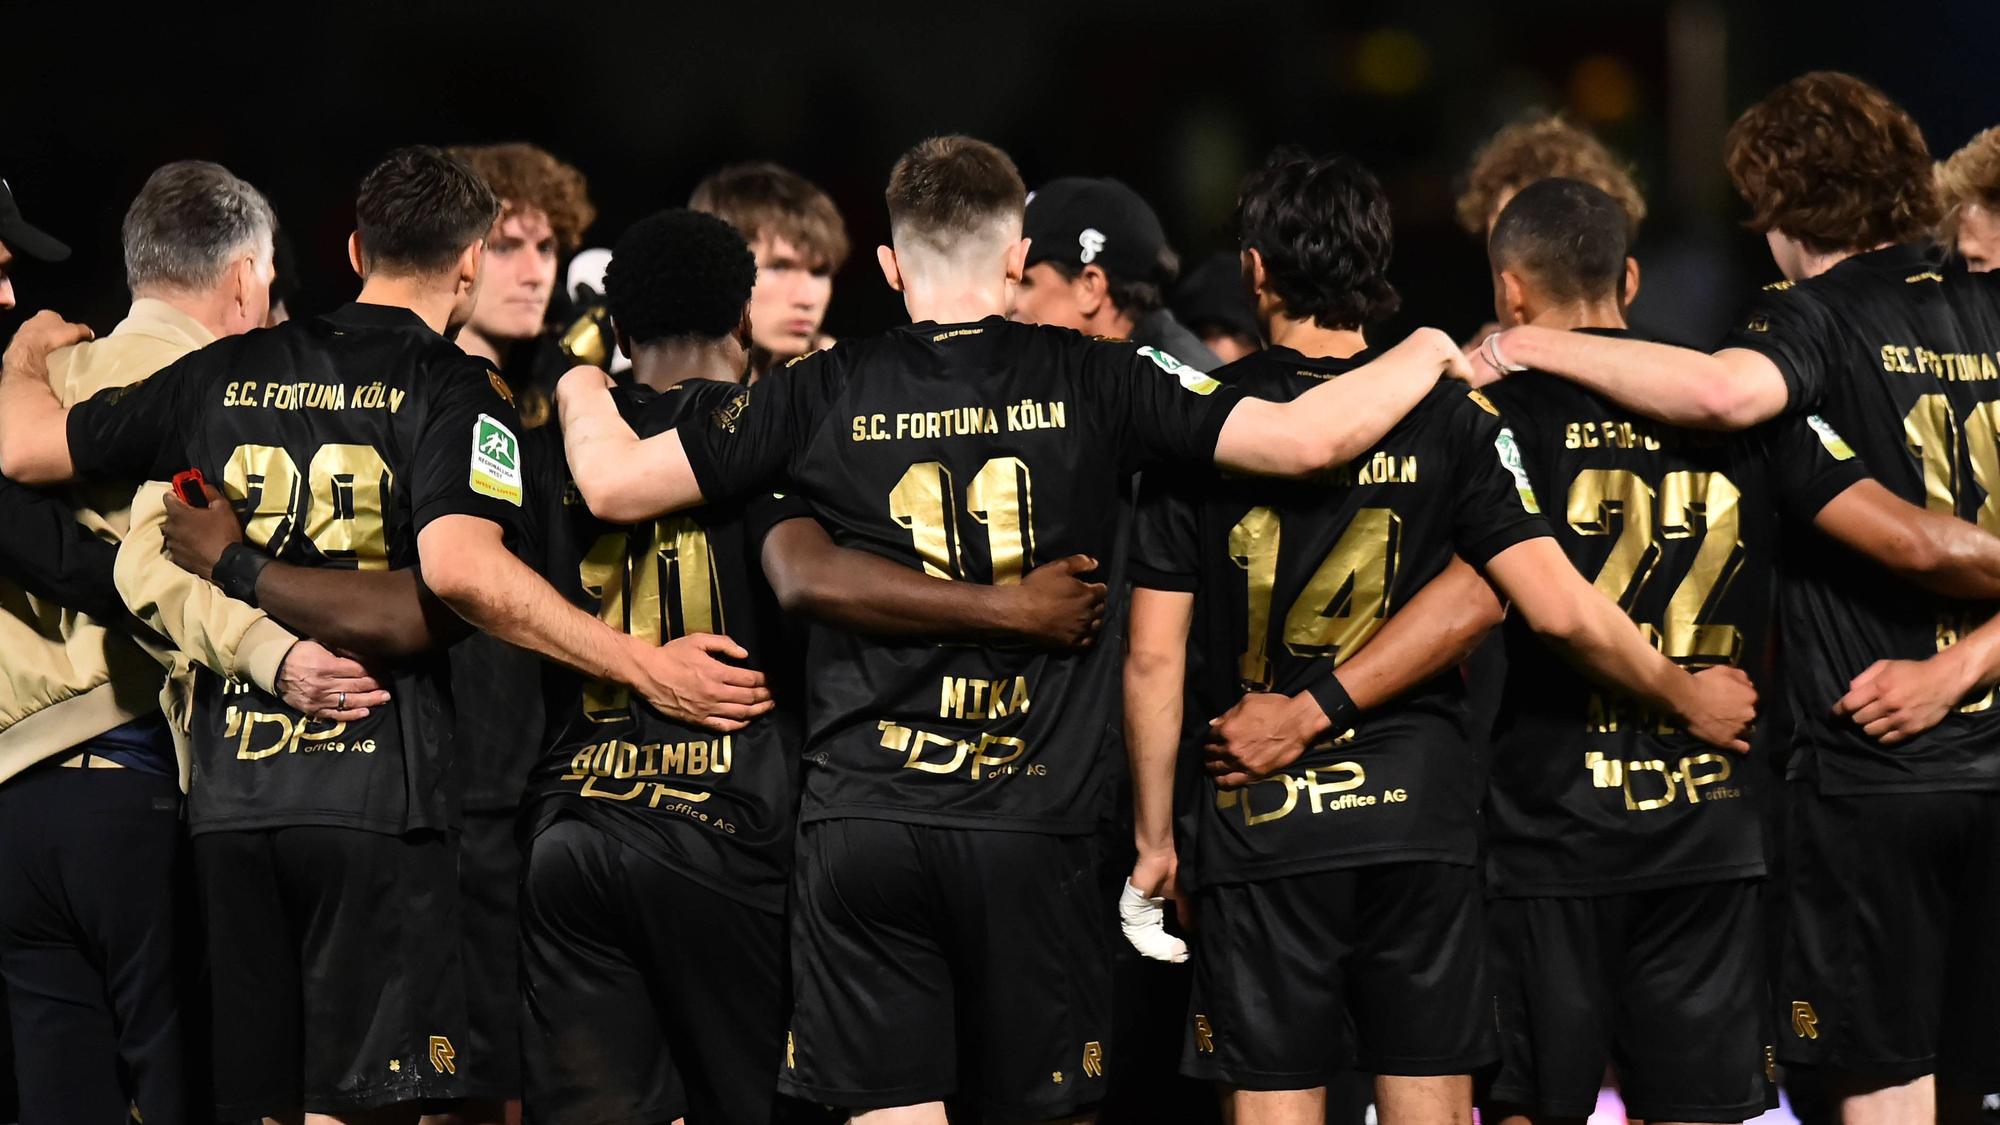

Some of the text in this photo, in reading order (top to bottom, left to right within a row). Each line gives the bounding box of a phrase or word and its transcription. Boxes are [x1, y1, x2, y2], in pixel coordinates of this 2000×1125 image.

[223, 381, 406, 414] S.C. FORTUNA KÖLN
[852, 398, 1066, 442] S.C. FORTUNA KÖLN
[1358, 451, 1418, 486] KÖLN
[888, 456, 1037, 587] 11
[1566, 468, 1747, 669] 22
[1228, 504, 1404, 693] 14
[939, 675, 1031, 720] MIKA
[350, 738, 377, 754] AG
[570, 734, 733, 780] BUDIMBU
[1026, 763, 1048, 777] AG
[665, 803, 737, 835] office AG
[1329, 787, 1409, 812] office AG
